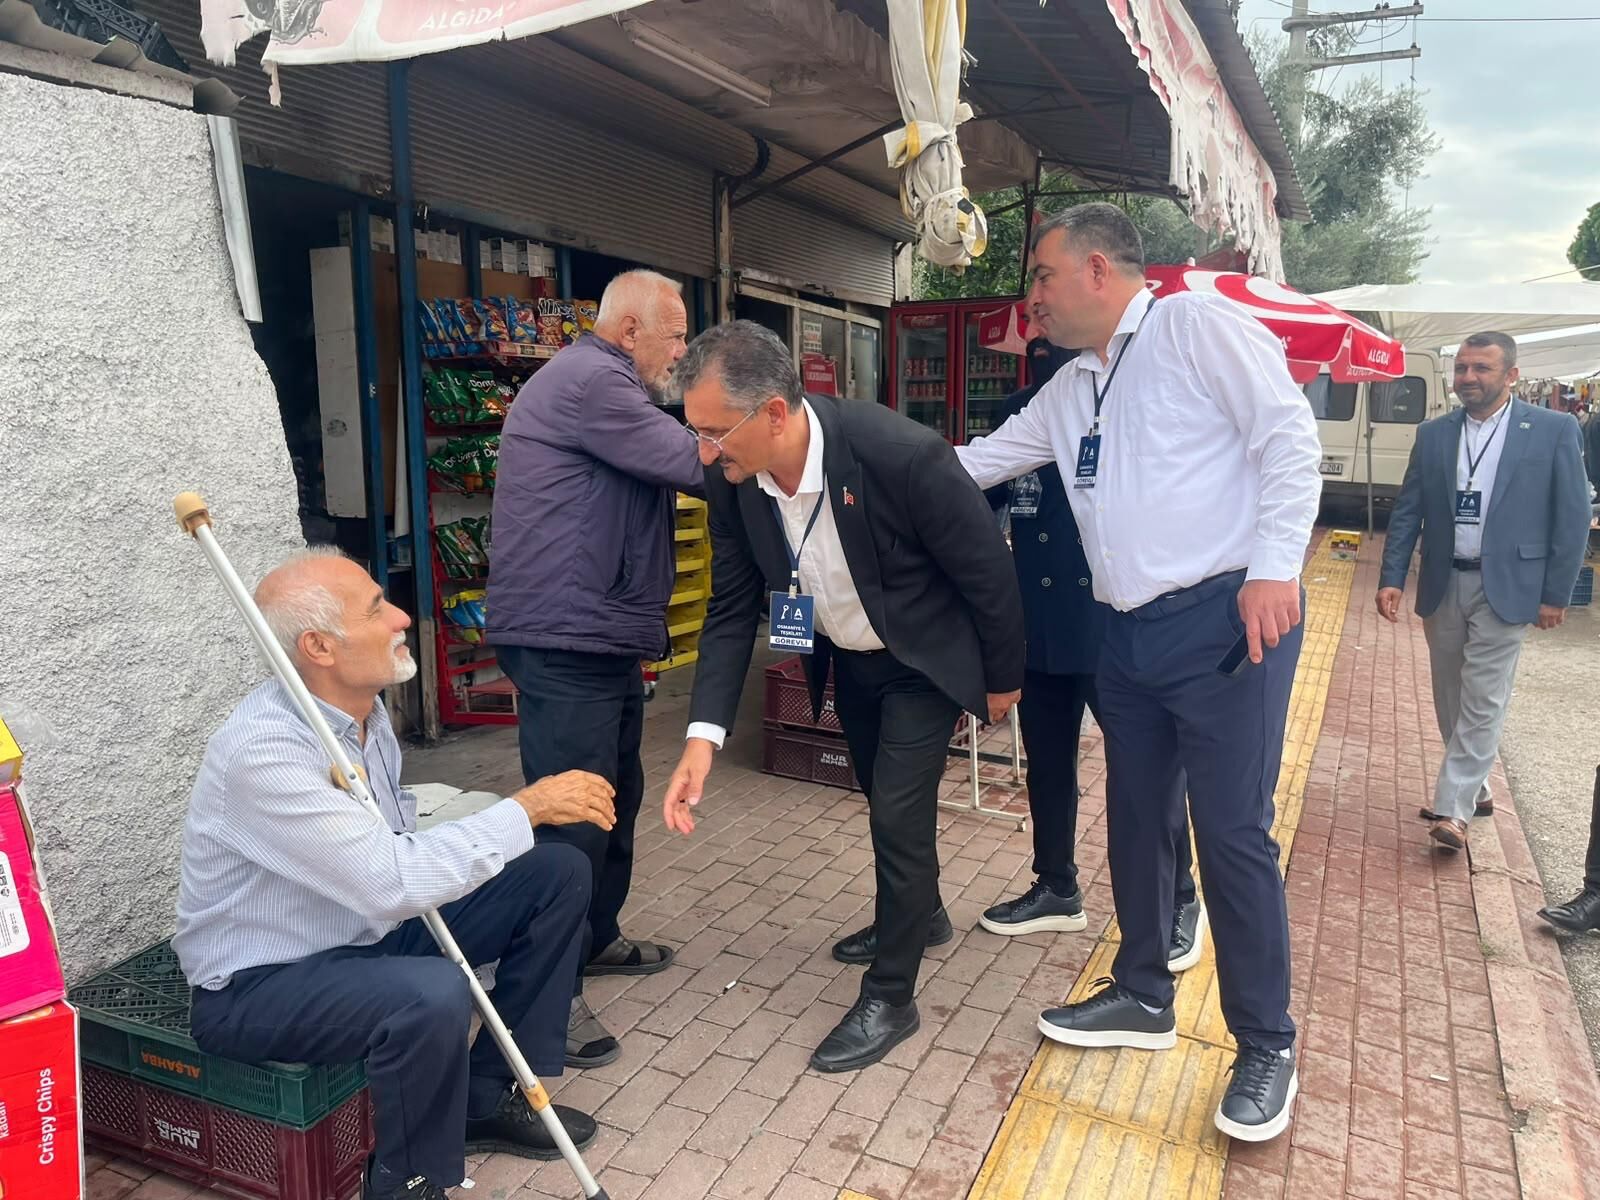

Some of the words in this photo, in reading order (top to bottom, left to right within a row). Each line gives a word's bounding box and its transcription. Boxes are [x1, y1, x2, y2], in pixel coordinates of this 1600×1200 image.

[774, 637, 808, 646] GÖREVLİ
[822, 752, 847, 763] NUR
[36, 1067, 56, 1113] Chips
[152, 1116, 201, 1139] EKMEK
[156, 1125, 198, 1149] NUR
[38, 1116, 57, 1165] Crispy
